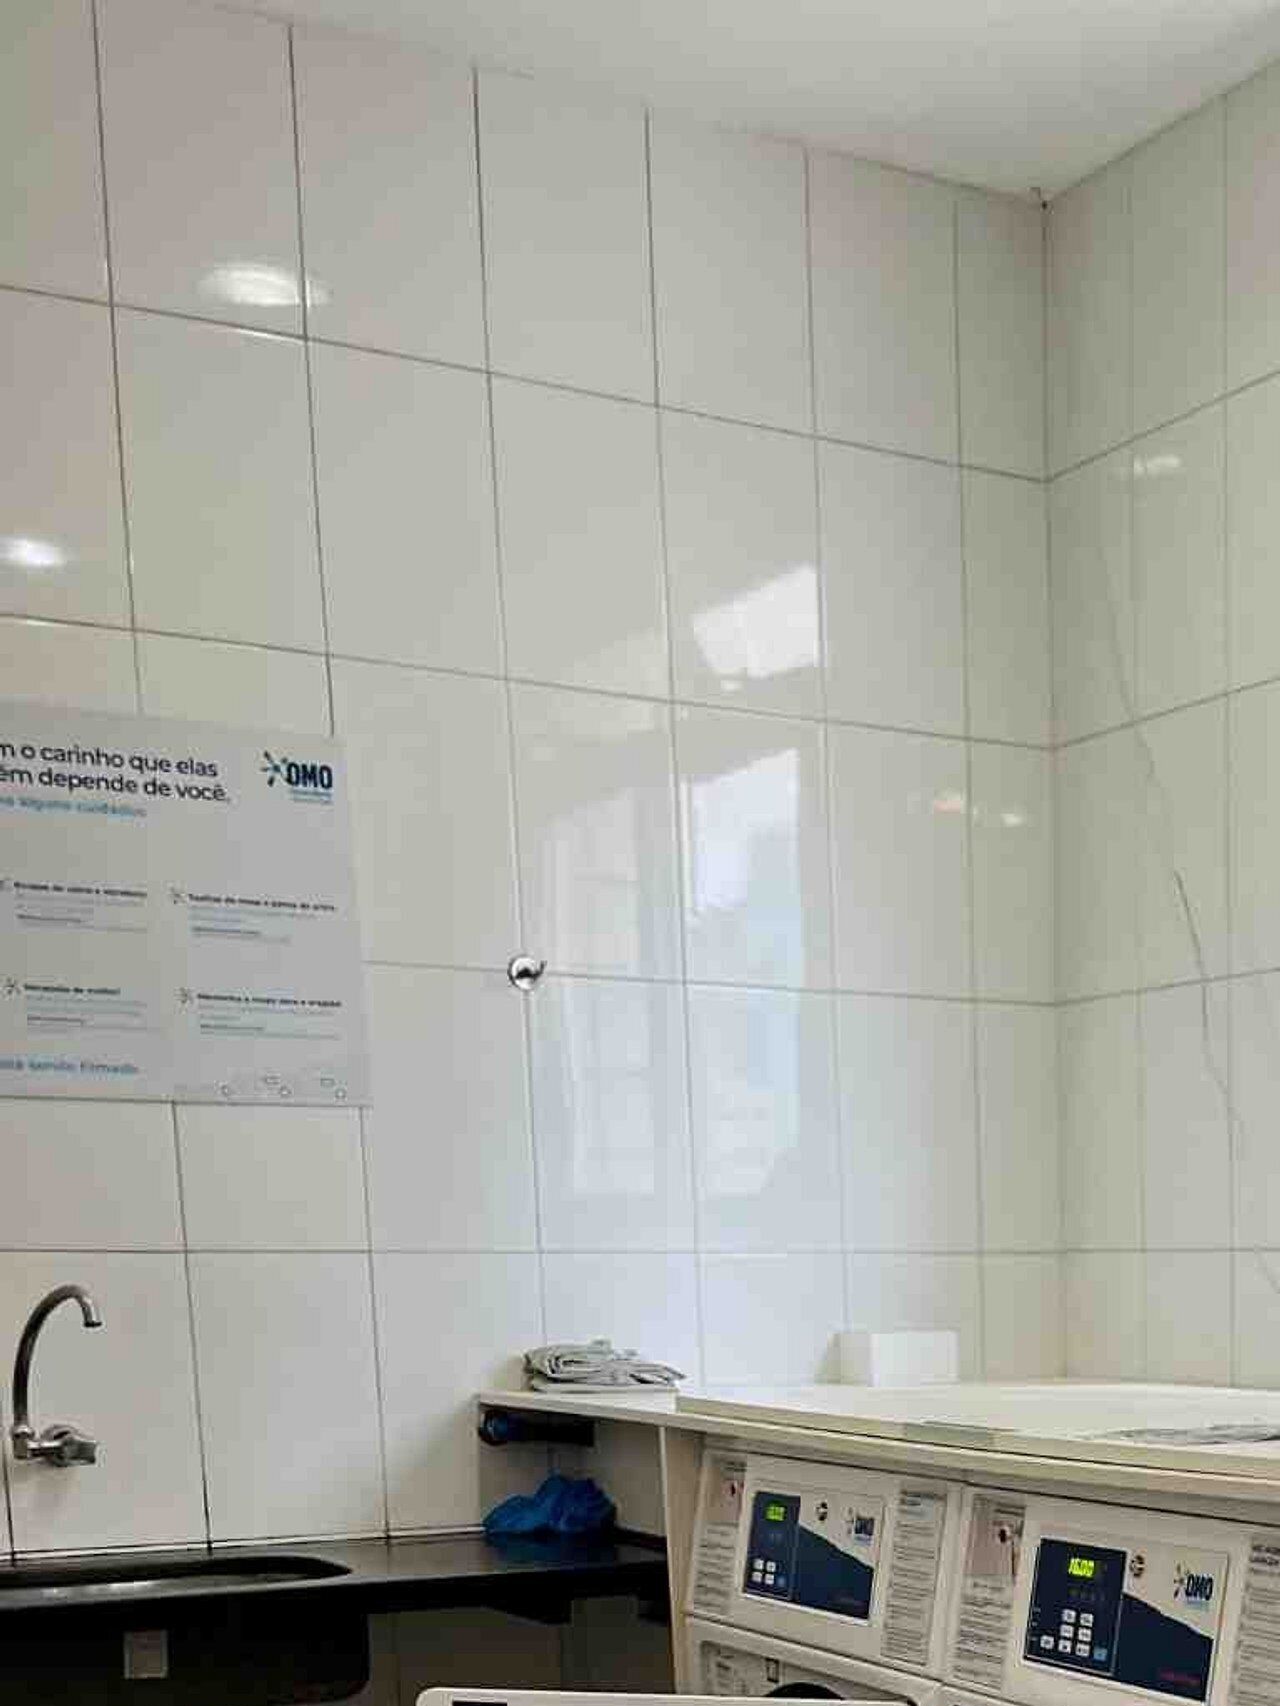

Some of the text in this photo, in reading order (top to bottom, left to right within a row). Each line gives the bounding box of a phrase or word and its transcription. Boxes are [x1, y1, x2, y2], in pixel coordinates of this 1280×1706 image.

[20, 744, 36, 760] o
[40, 745, 125, 768] carinho
[129, 753, 172, 774] que
[175, 757, 219, 778] elas
[286, 761, 333, 789] OMO
[38, 768, 138, 796] depende
[143, 777, 171, 796] de
[1185, 1573, 1214, 1601] OMO
